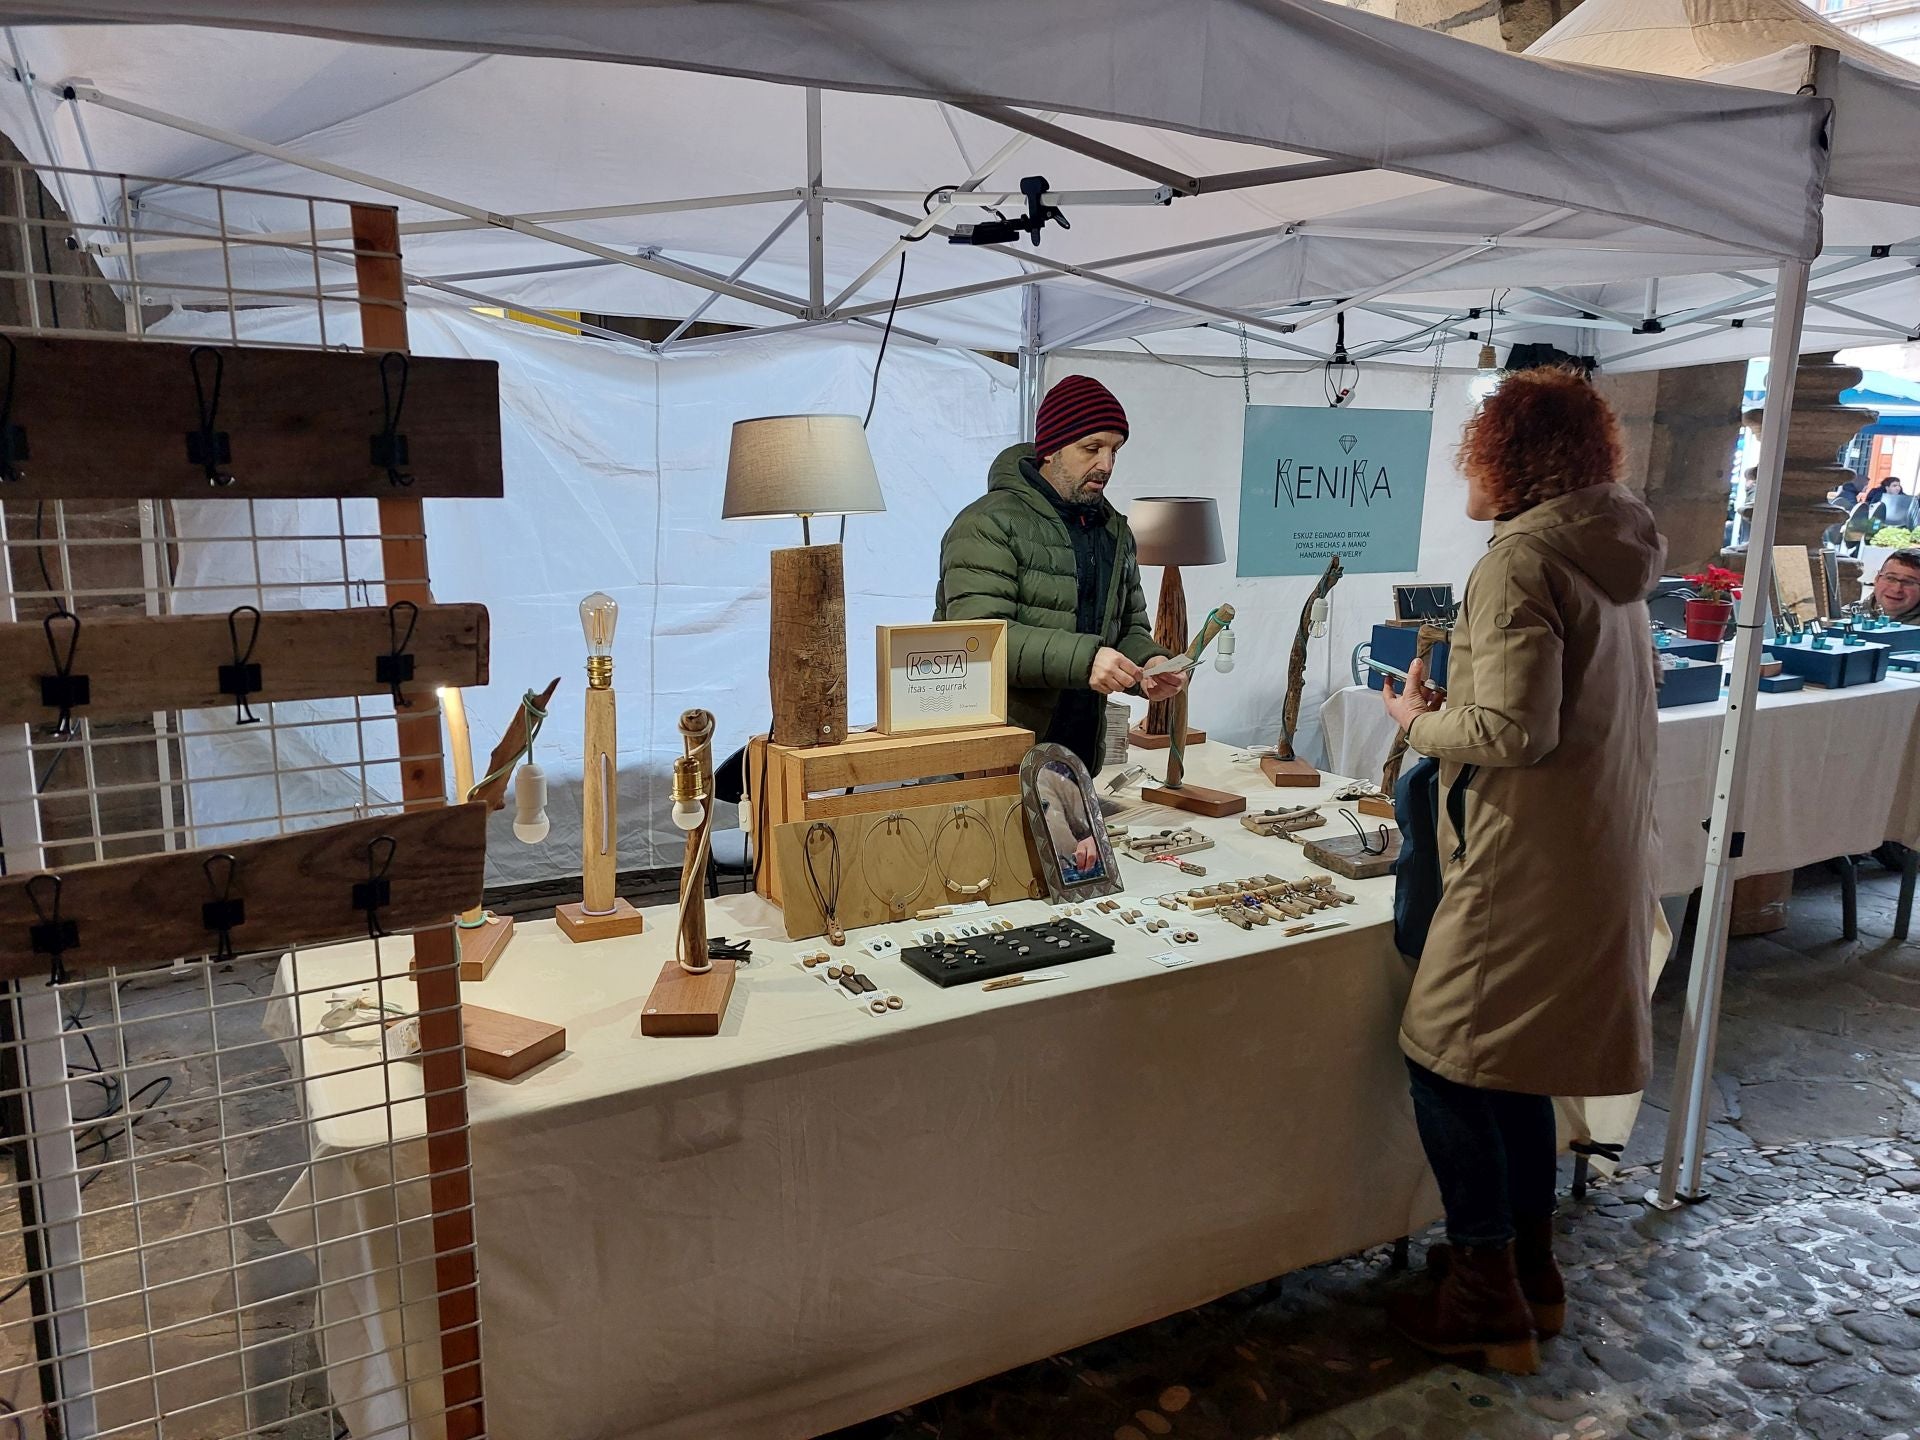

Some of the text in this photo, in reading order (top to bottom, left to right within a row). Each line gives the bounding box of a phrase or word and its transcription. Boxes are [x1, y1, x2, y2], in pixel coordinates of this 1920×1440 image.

[1274, 459, 1392, 508] KENIKA
[1314, 531, 1345, 539] EGINDAKO
[1315, 541, 1340, 549] HECHAS
[908, 684, 926, 694] itsas
[935, 680, 967, 694] egurrak
